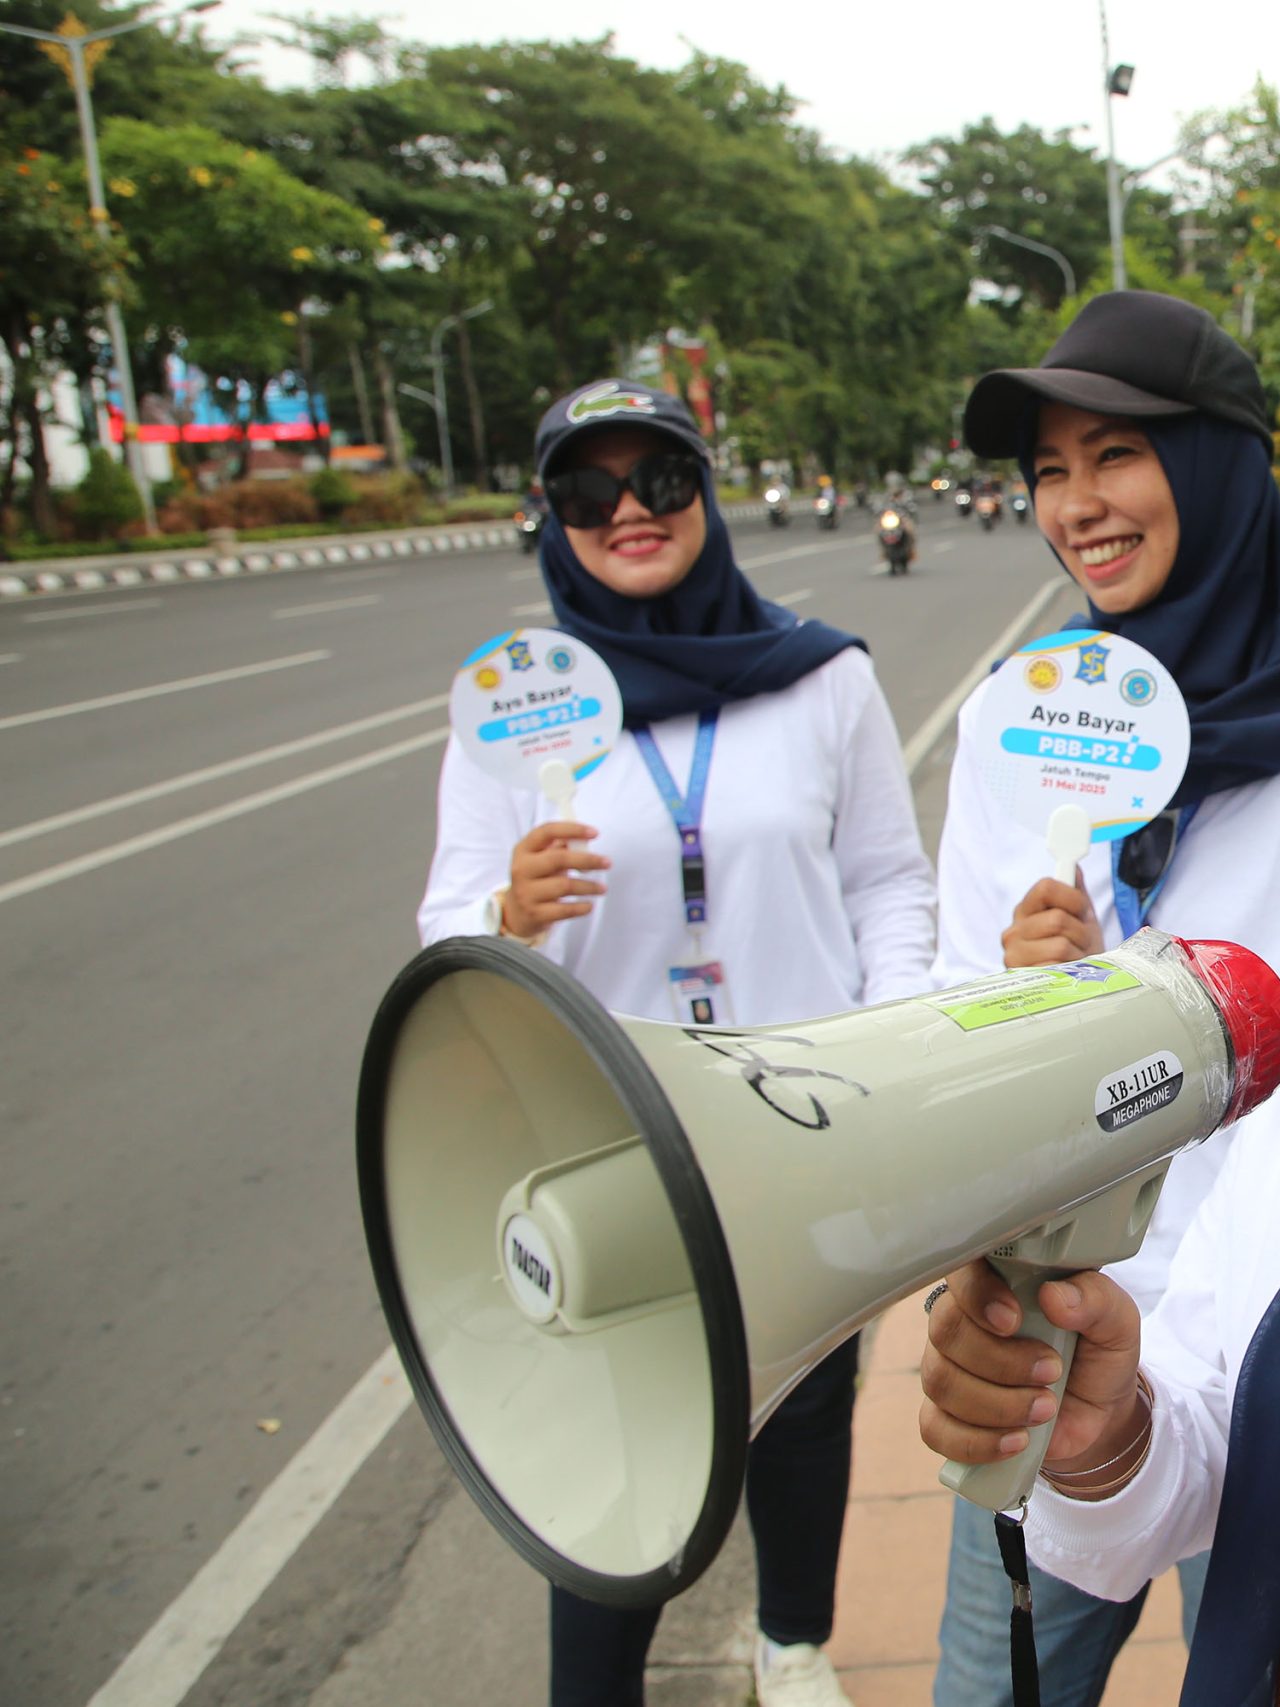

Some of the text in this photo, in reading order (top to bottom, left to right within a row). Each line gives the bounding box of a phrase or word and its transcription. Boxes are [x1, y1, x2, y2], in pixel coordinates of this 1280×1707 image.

[1030, 704, 1137, 735] Ayo Bayar
[1040, 763, 1111, 782] Jatuh Tempo
[1055, 780, 1076, 792] Mei
[1106, 1059, 1169, 1106] XB-11UR
[1112, 1085, 1171, 1127] MEGAPHONE
